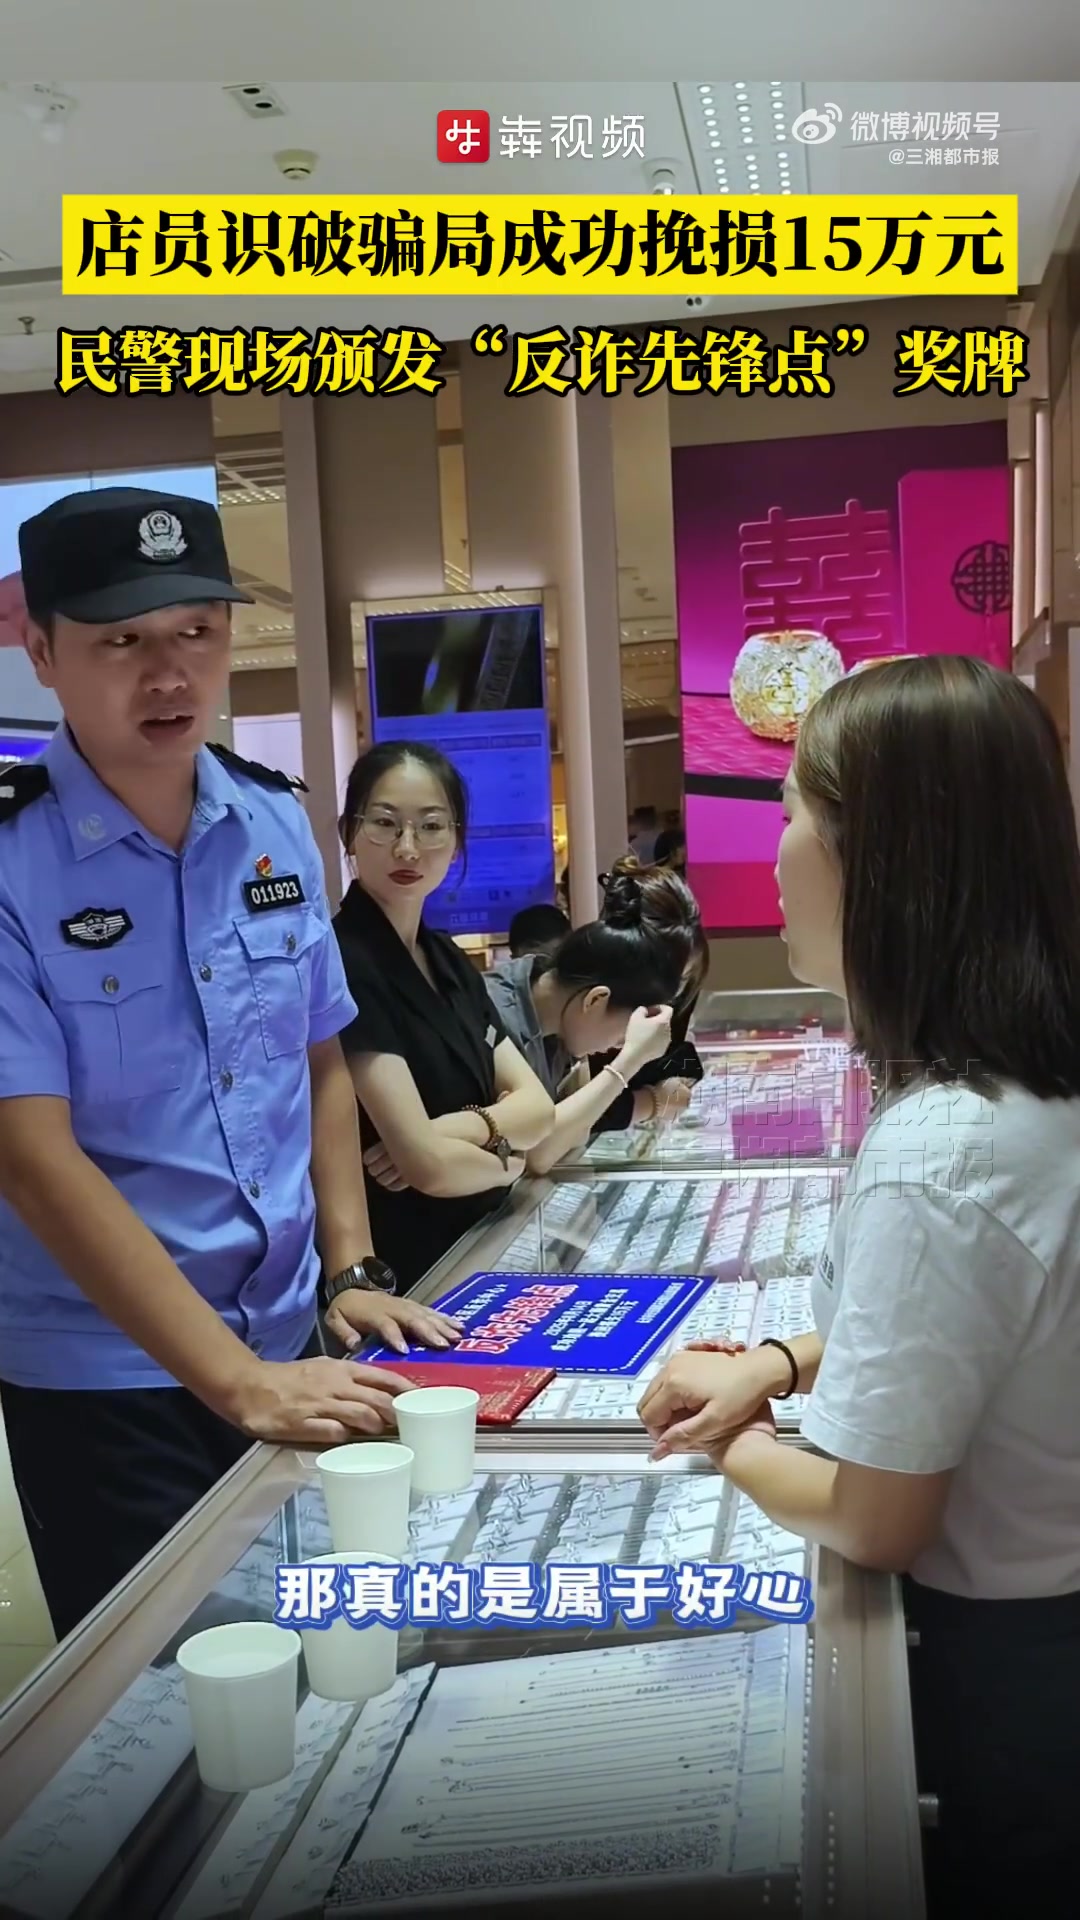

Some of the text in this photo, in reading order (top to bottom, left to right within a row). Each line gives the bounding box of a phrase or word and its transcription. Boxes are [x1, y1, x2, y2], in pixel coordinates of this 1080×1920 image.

[250, 881, 299, 905] 011923
[454, 1284, 579, 1354] 反诈先锋点
